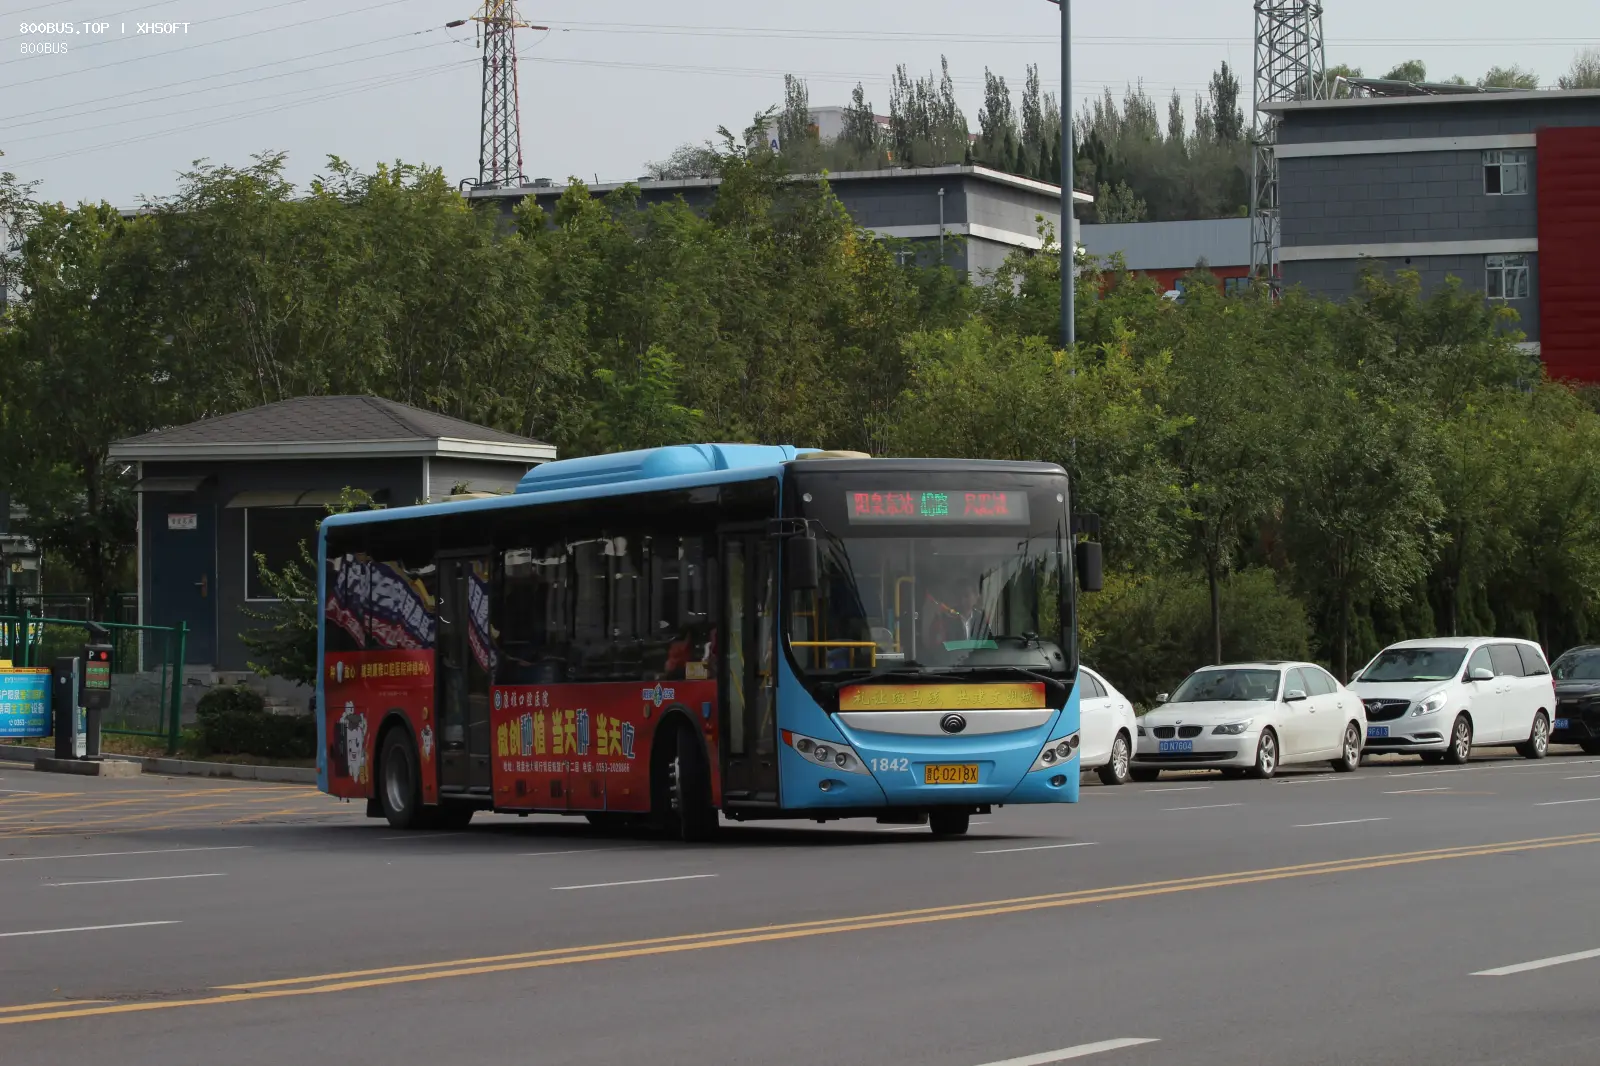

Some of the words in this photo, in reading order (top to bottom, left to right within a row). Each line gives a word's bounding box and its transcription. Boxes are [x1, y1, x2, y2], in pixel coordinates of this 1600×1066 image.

[88, 650, 95, 660] P
[852, 688, 944, 707] 礼让斑马线
[956, 688, 1036, 706] 共建文明城
[497, 709, 546, 757] 微创种植
[551, 708, 590, 756] 当天种
[596, 712, 636, 759] 当天吃
[869, 758, 909, 772] 1842
